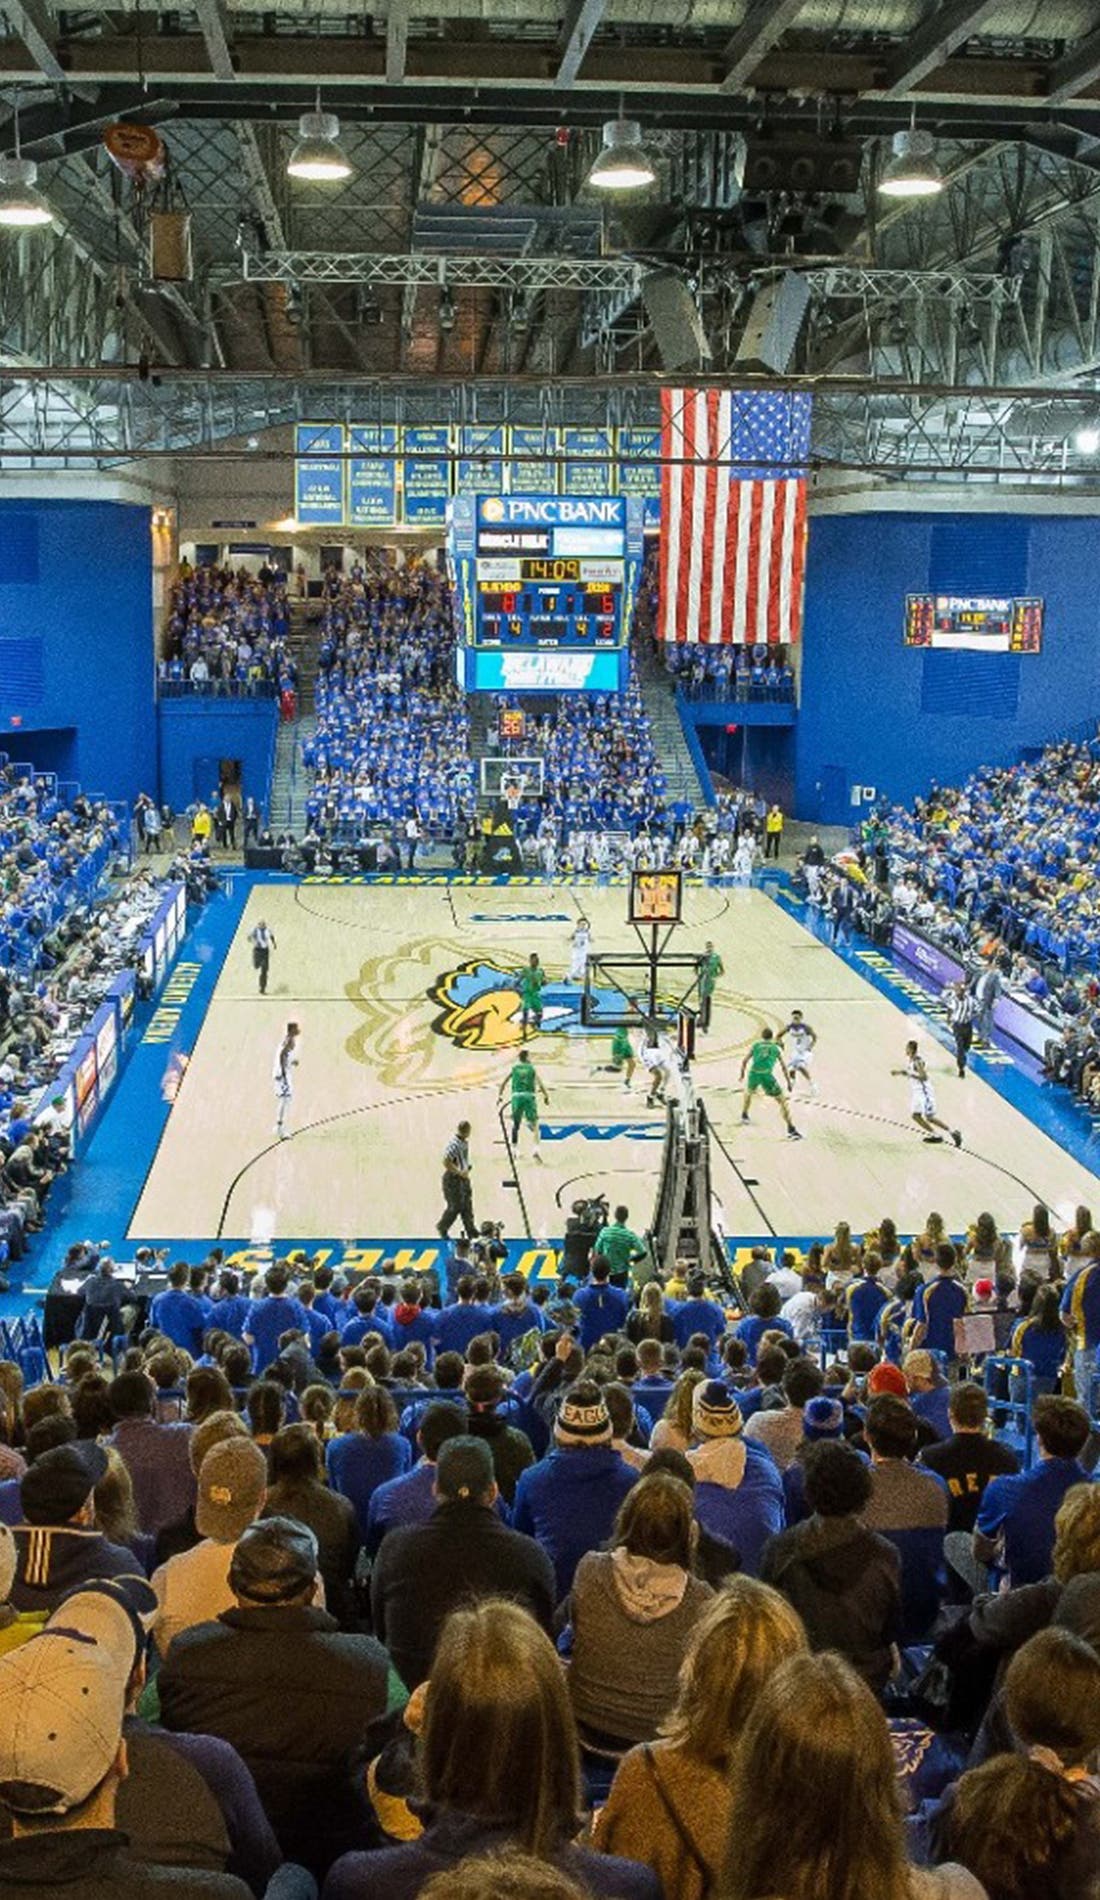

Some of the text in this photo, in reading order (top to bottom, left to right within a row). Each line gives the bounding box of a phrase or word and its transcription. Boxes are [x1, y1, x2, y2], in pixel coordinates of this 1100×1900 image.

[508, 502, 621, 521] PNC BANK
[530, 560, 578, 580] 14:09
